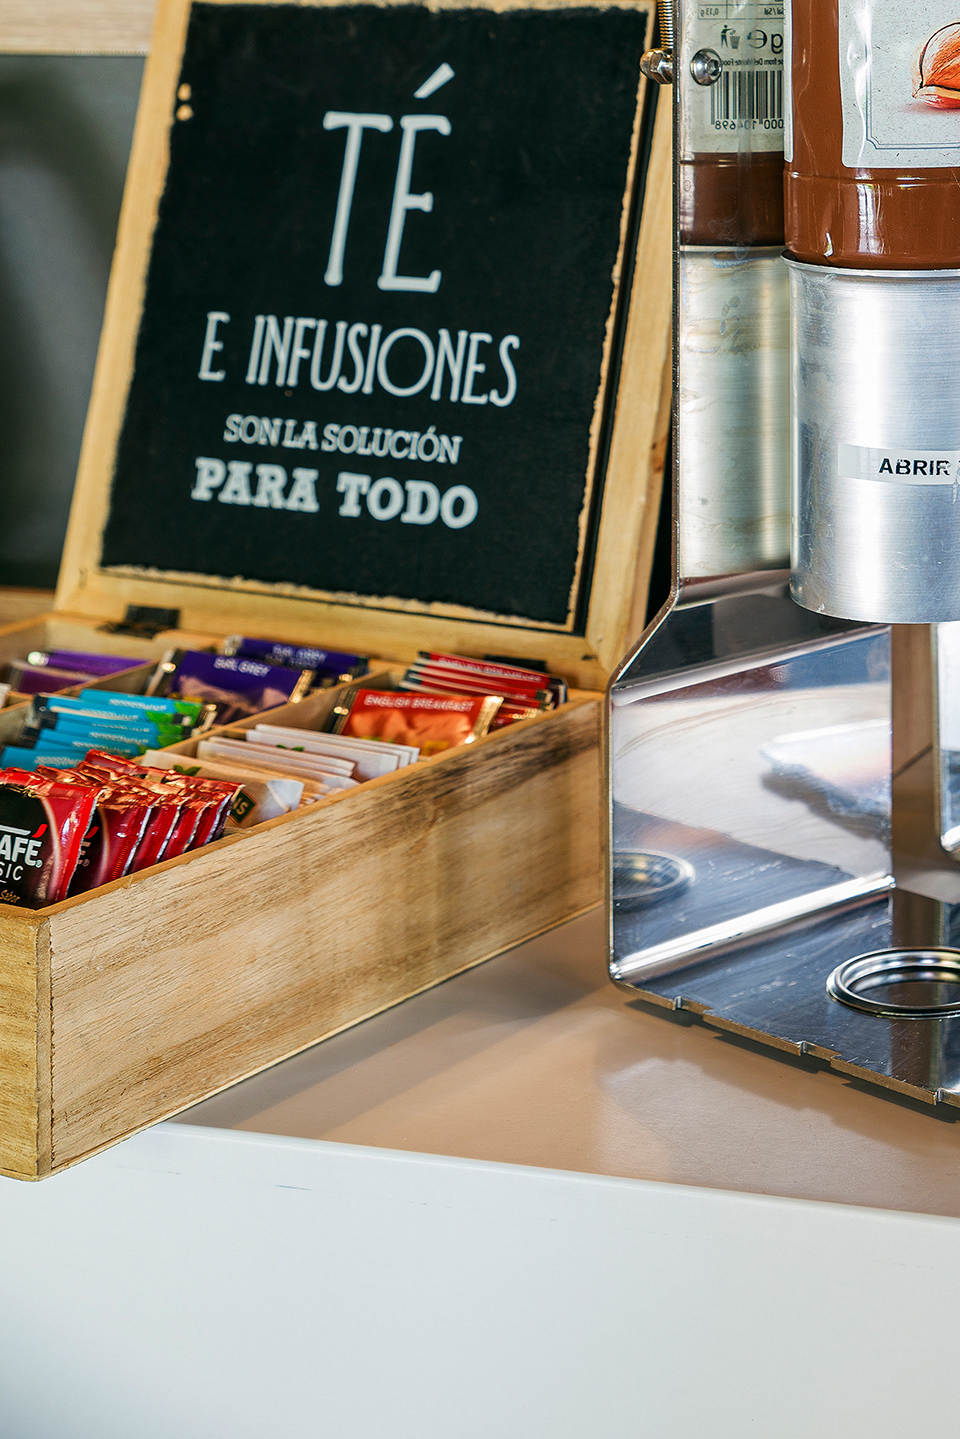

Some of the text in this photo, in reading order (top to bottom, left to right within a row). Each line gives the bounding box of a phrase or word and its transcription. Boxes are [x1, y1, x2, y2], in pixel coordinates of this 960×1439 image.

[322, 62, 455, 293] TÉ
[198, 311, 521, 407] E INFUSIONES
[223, 413, 464, 465] SON LA SOLUCIÓN
[878, 457, 951, 476] ABRIR
[190, 455, 480, 530] PARA TODO
[364, 694, 475, 713] ENGLISH BREAKFAST
